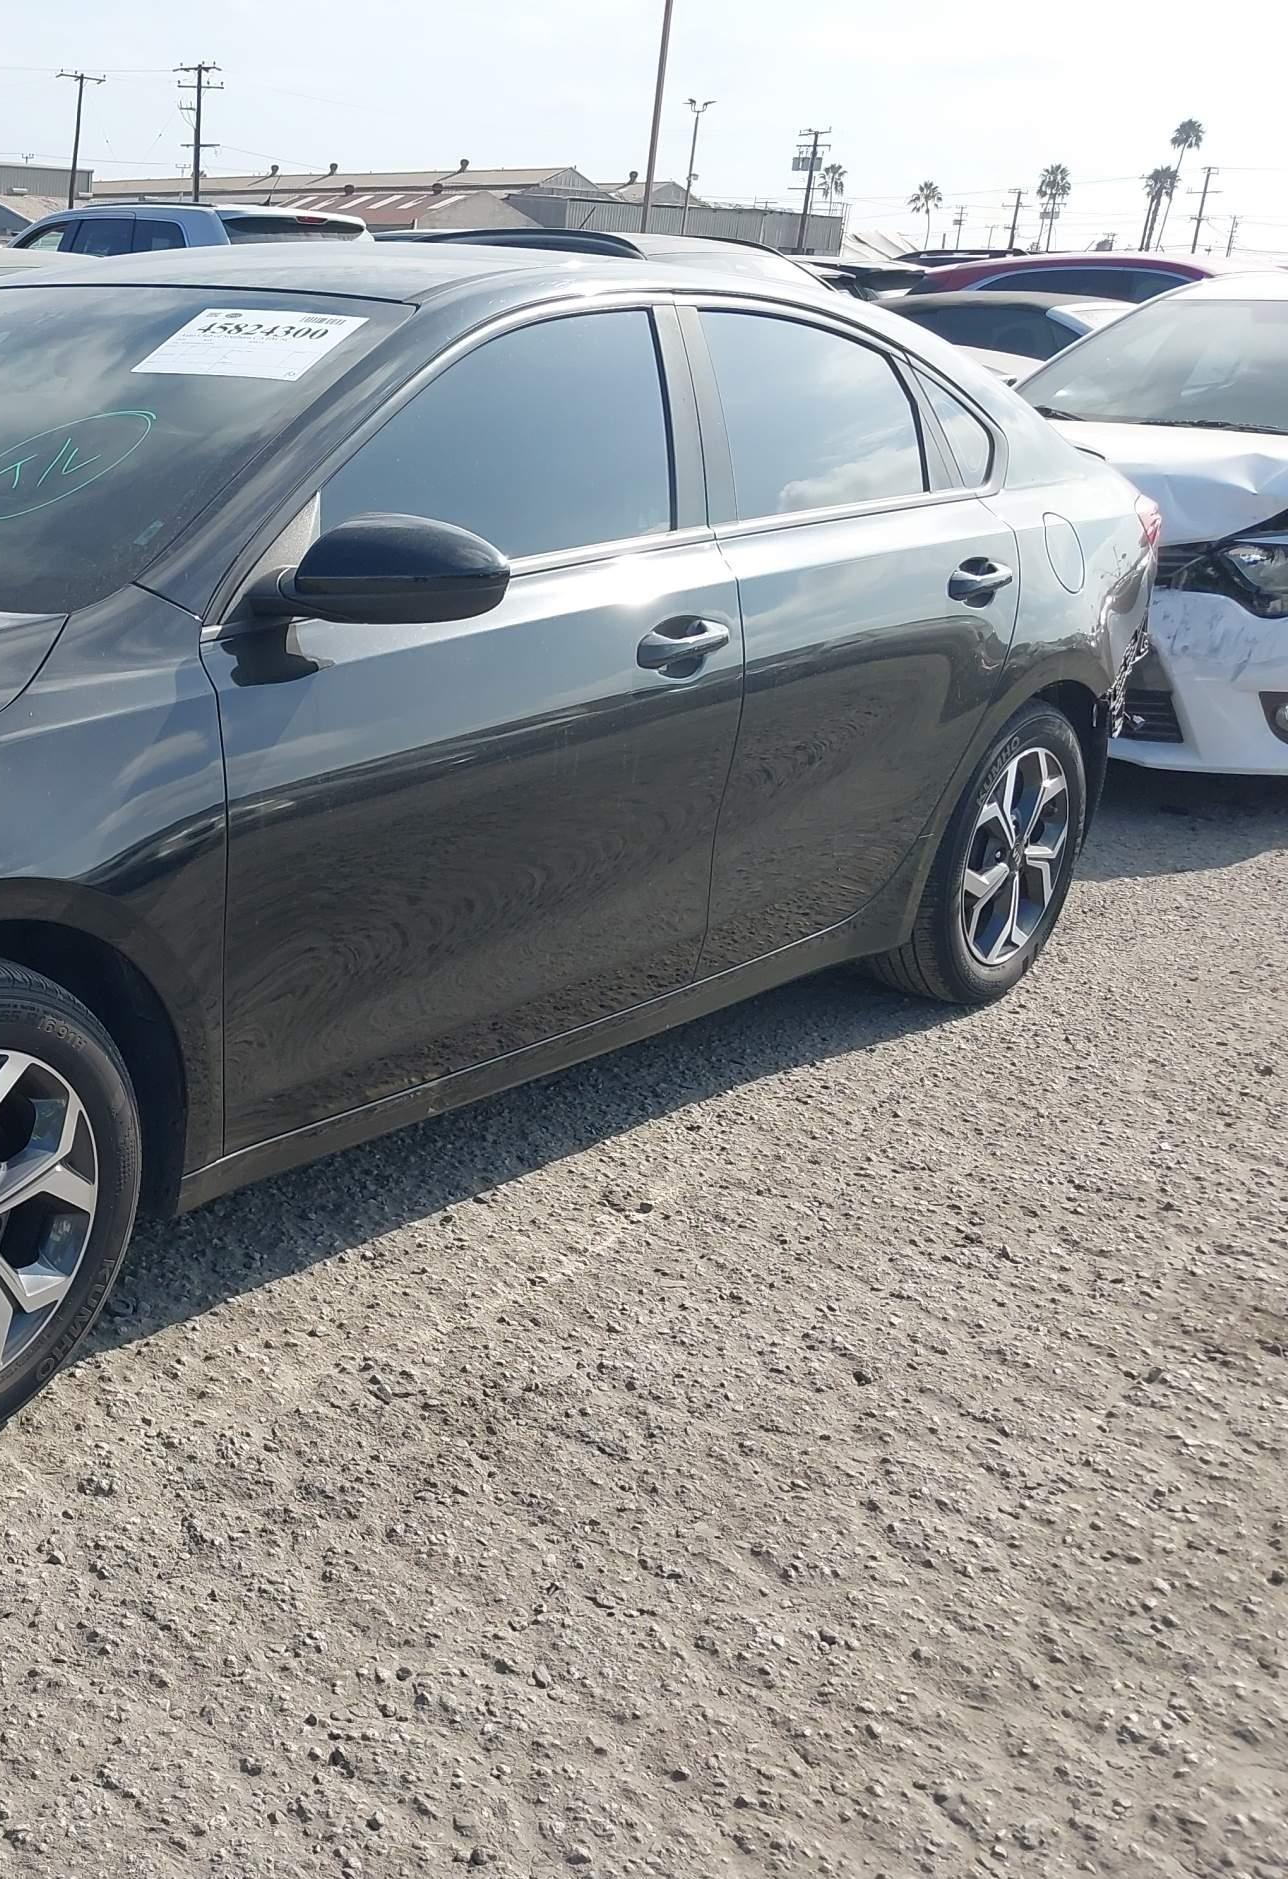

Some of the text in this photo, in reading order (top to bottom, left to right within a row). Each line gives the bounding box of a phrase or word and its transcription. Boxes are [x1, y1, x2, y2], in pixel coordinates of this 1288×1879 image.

[197, 321, 329, 341] 45824300
[976, 736, 1020, 808] KUMHO
[35, 1258, 116, 1384] KUMHO
